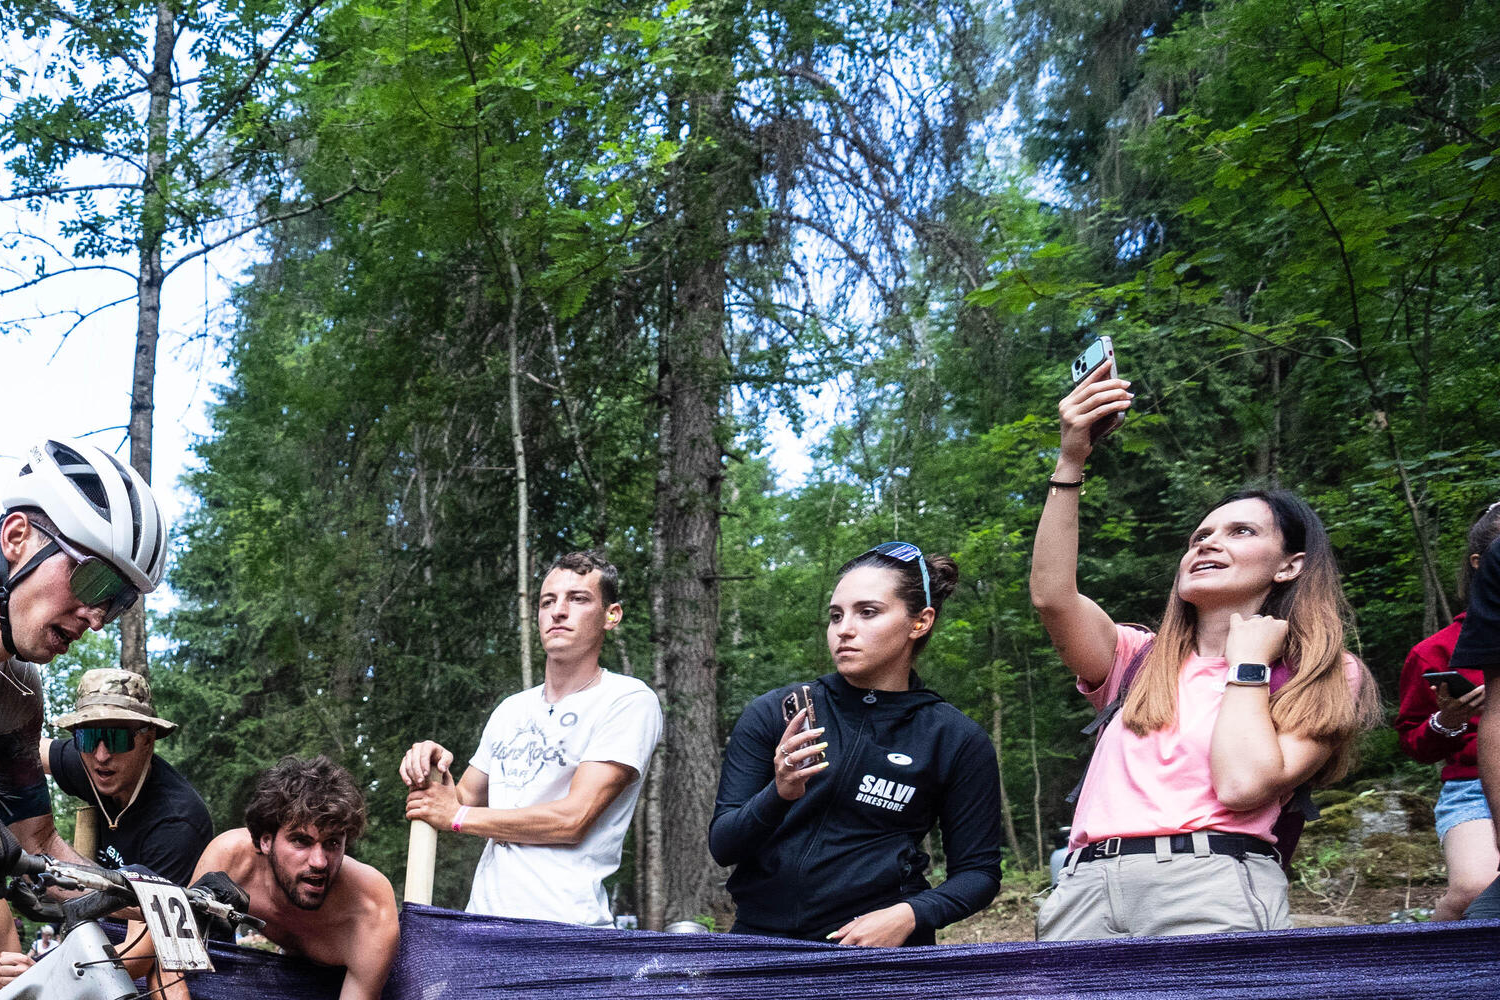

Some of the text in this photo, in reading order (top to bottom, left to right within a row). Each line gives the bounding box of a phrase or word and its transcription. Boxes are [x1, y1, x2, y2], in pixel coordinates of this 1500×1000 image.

[855, 792, 905, 812] BIKESTORE
[859, 774, 916, 804] SALVI
[151, 894, 194, 939] 12
